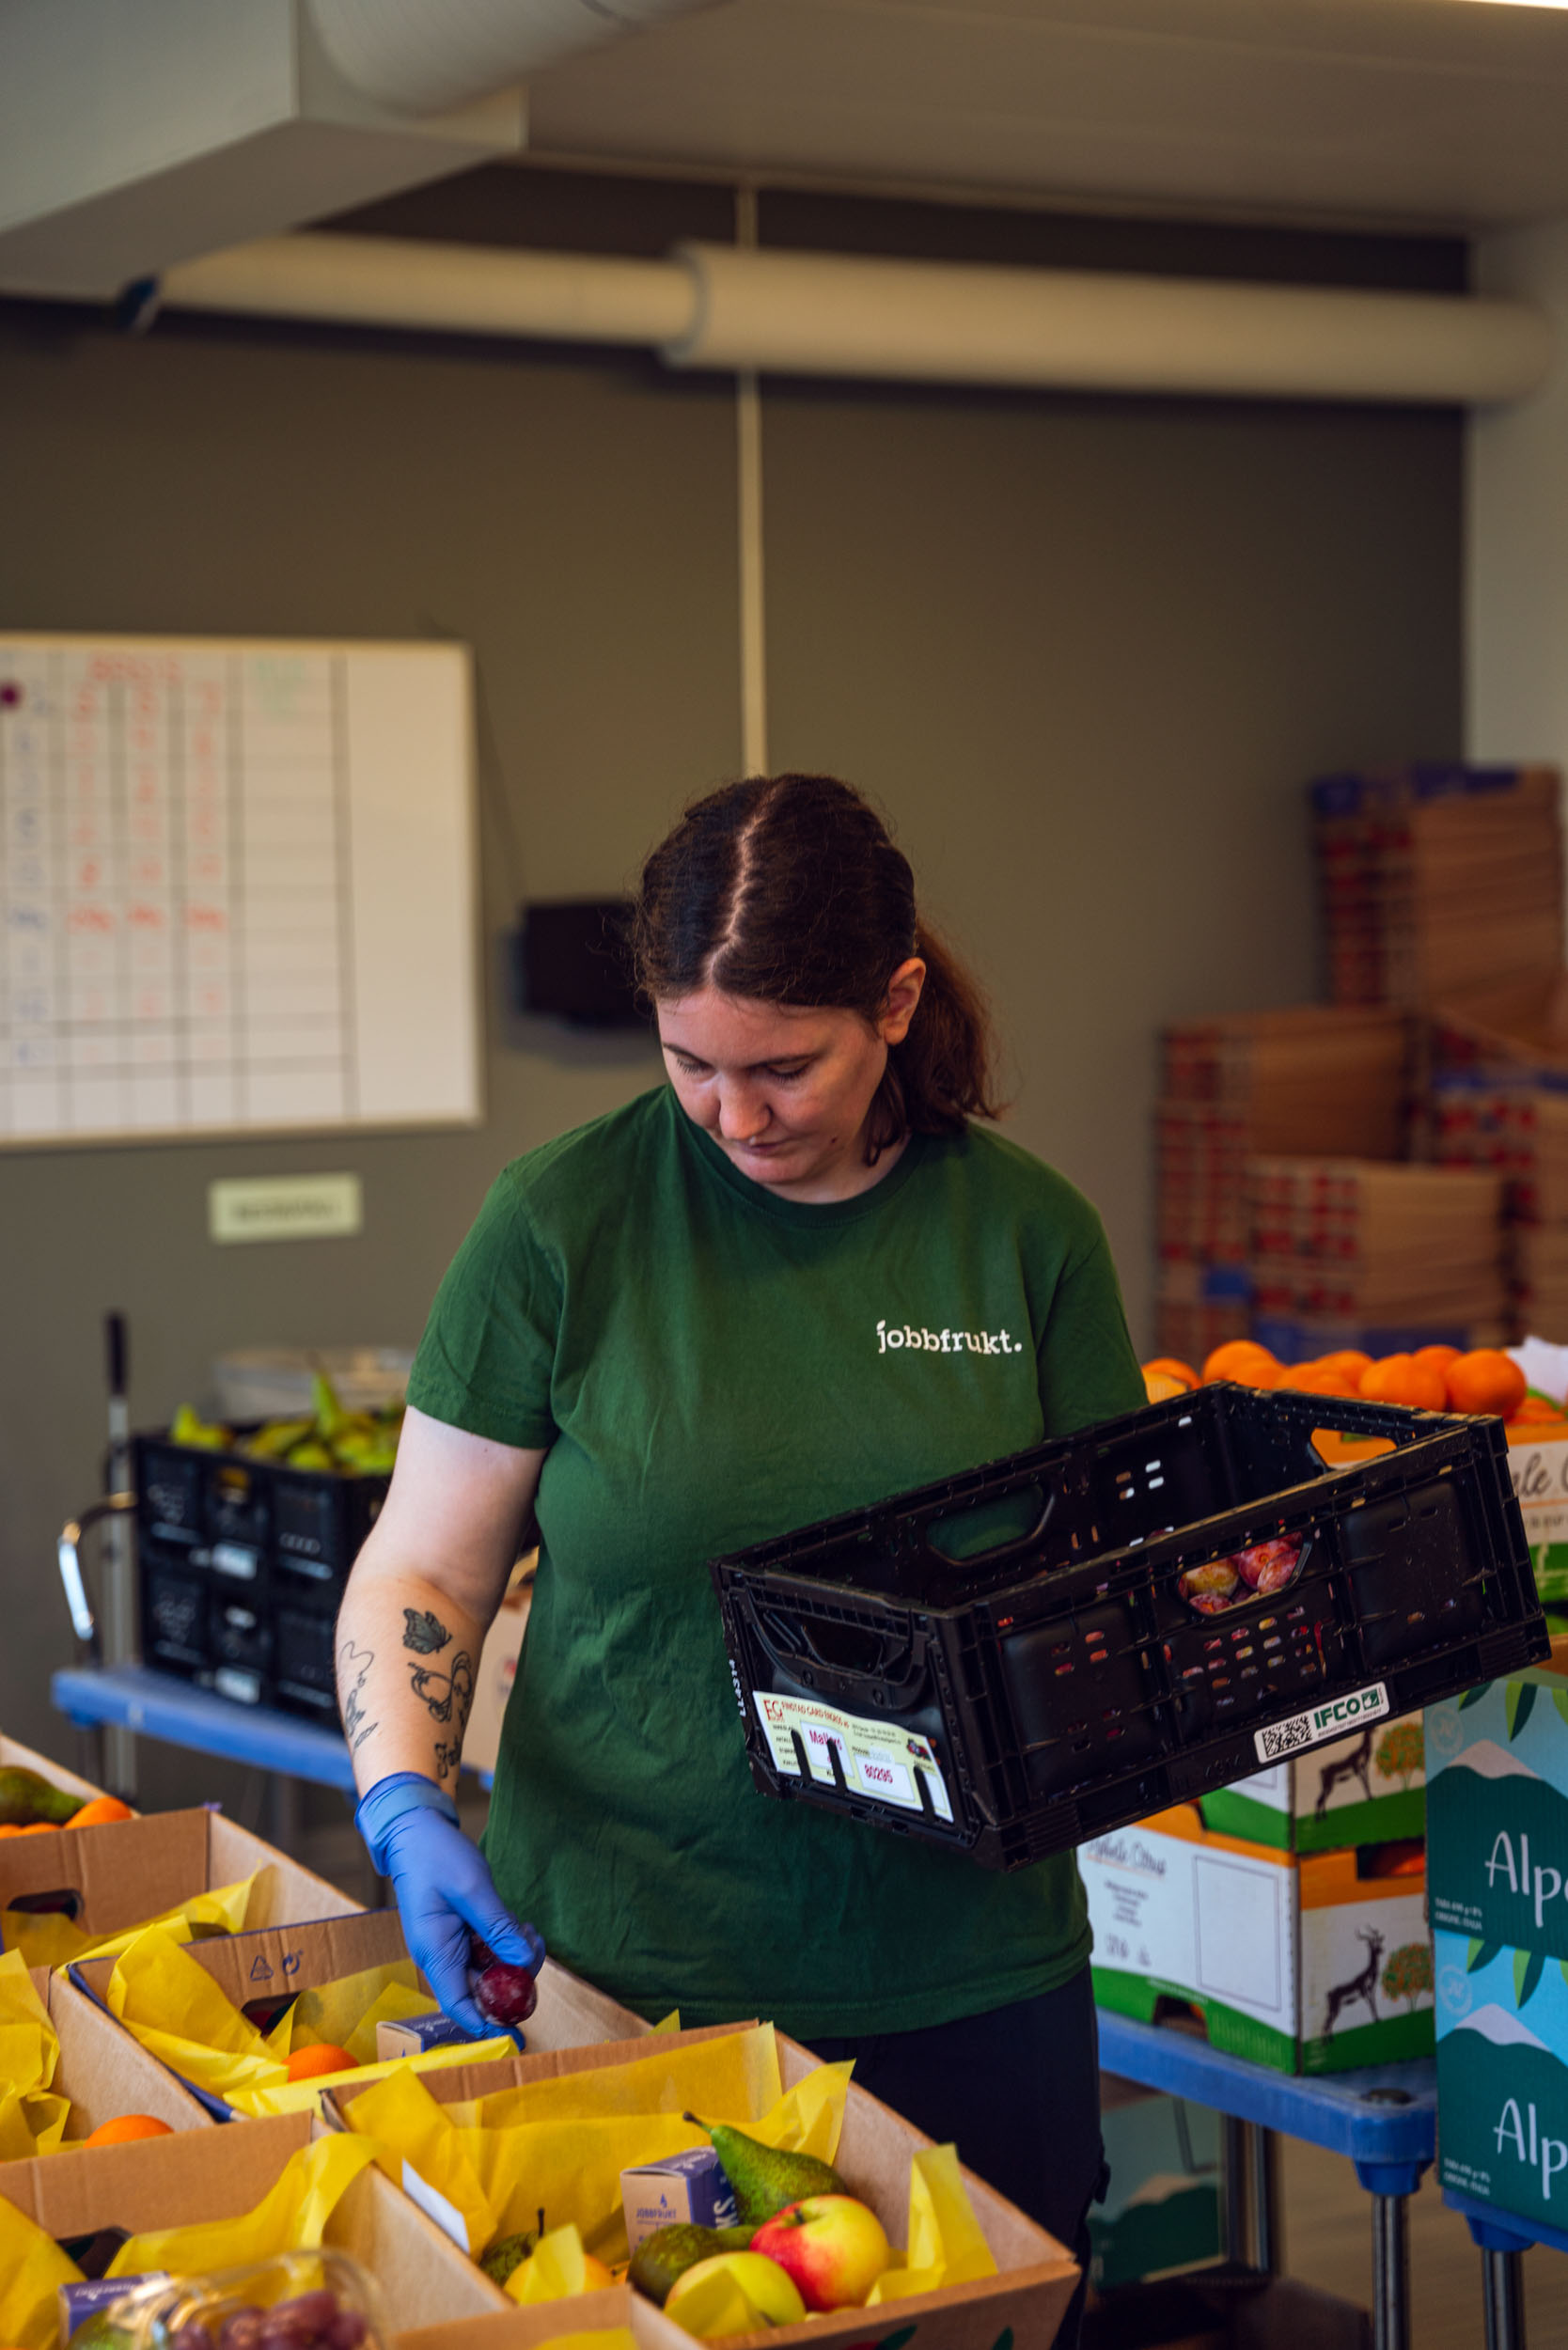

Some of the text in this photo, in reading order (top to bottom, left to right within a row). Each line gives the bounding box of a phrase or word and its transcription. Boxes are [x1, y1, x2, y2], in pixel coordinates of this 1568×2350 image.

[876, 1320, 1023, 1355] jobbfrukt.
[1313, 1698, 1361, 1730] IFCO
[1484, 1830, 1568, 1929] Alp
[636, 2207, 677, 2219] JOBBFRUKT
